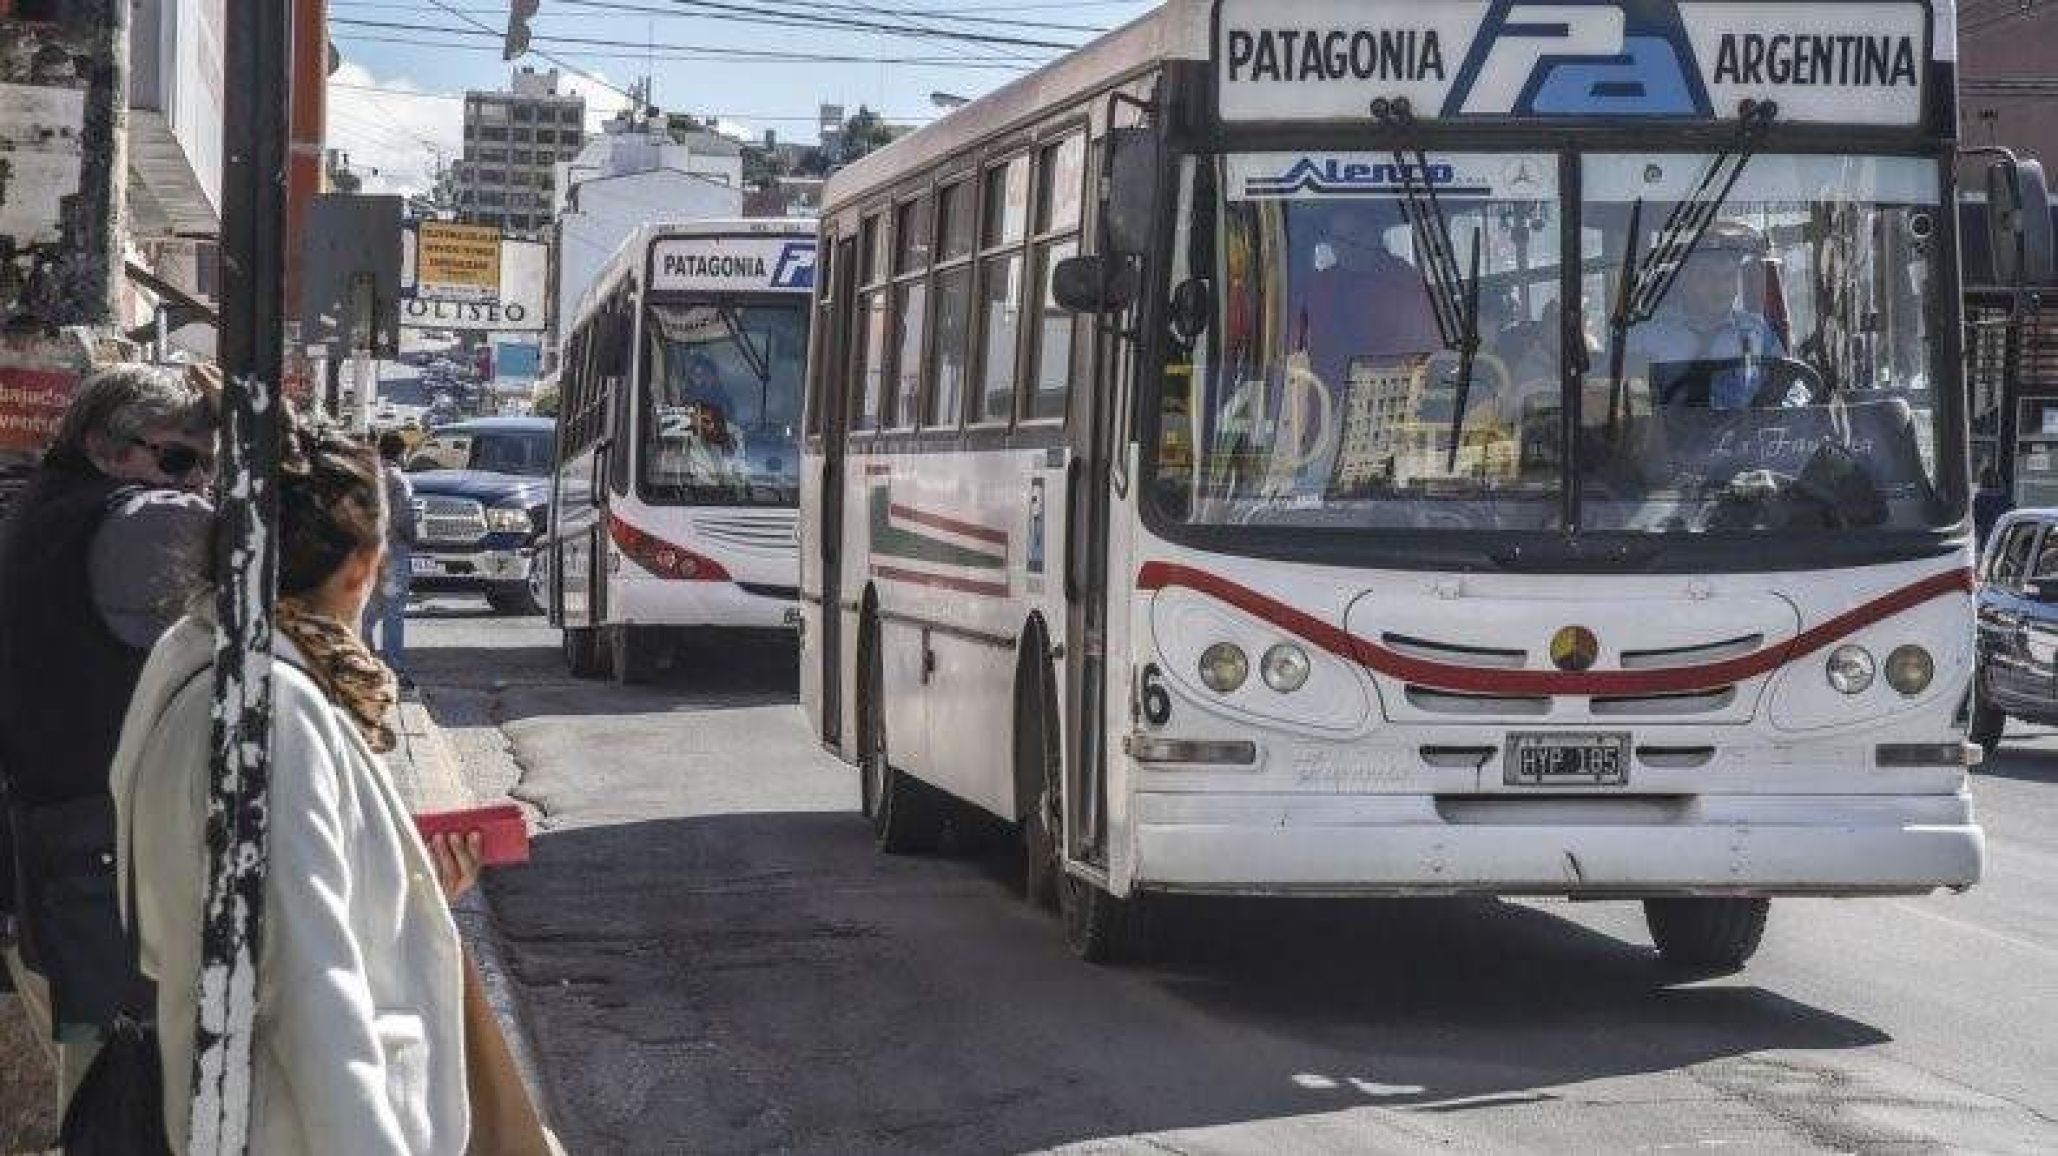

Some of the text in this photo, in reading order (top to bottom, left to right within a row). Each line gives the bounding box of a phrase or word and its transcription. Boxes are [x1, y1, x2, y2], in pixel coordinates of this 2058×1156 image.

[1229, 29, 1444, 82] PATAGONIA
[1713, 33, 1917, 87] ARGENTINA
[663, 255, 767, 277] PATAGONIA
[407, 298, 525, 322] OLISEO
[1578, 747, 1617, 773] 185
